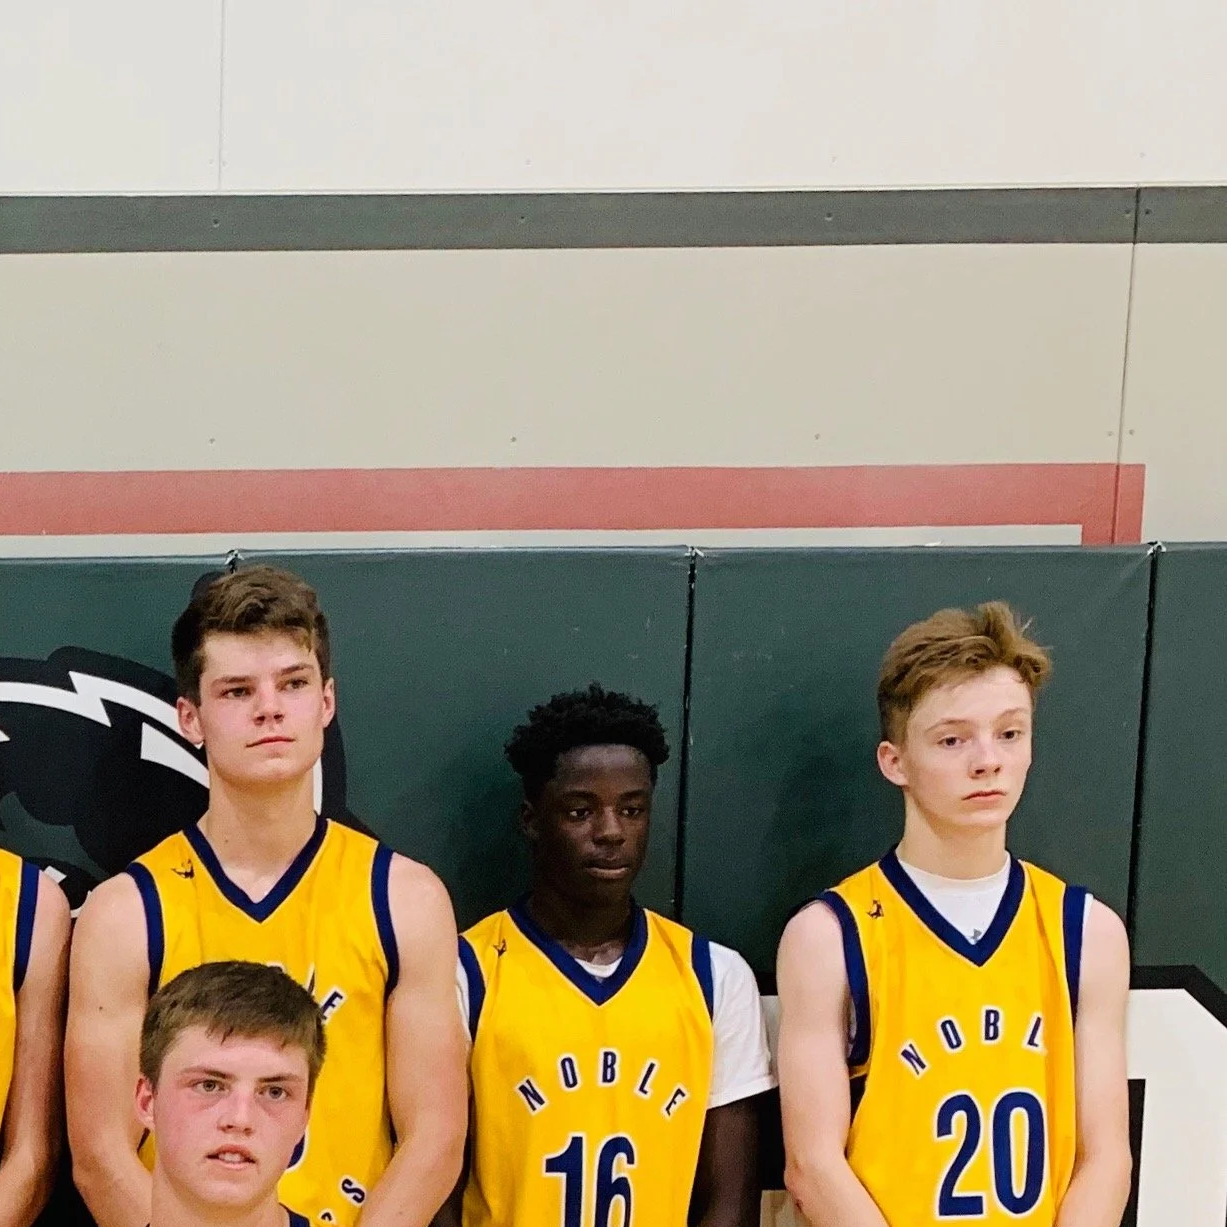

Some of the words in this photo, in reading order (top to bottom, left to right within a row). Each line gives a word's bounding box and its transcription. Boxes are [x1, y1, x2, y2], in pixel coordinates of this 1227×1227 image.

[900, 1006, 1045, 1076] NOBL
[519, 1049, 688, 1119] NOBLE
[934, 1089, 1047, 1220] 20
